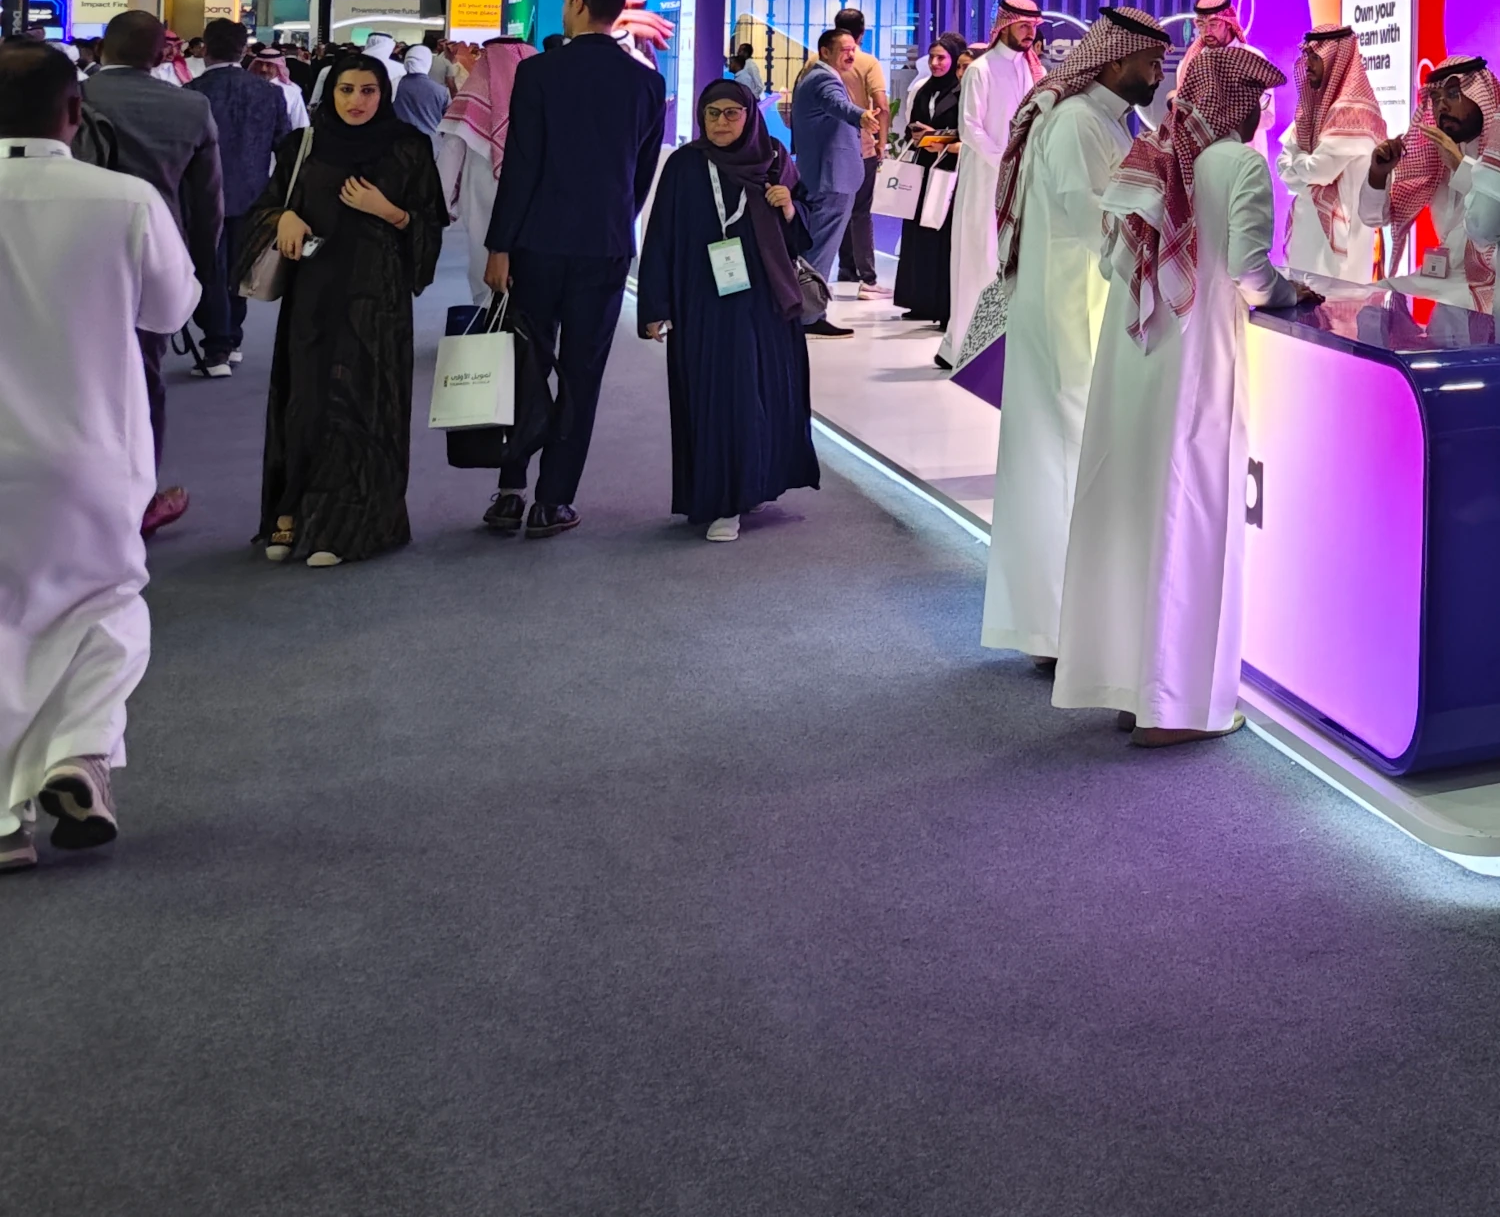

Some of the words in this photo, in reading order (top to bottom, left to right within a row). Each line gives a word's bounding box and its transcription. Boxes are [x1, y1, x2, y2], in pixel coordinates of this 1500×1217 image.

[12, 11, 22, 35] DEL
[1354, 5, 1374, 23] Own
[1375, 1, 1396, 24] your
[1356, 30, 1378, 47] eam
[1379, 23, 1400, 43] with
